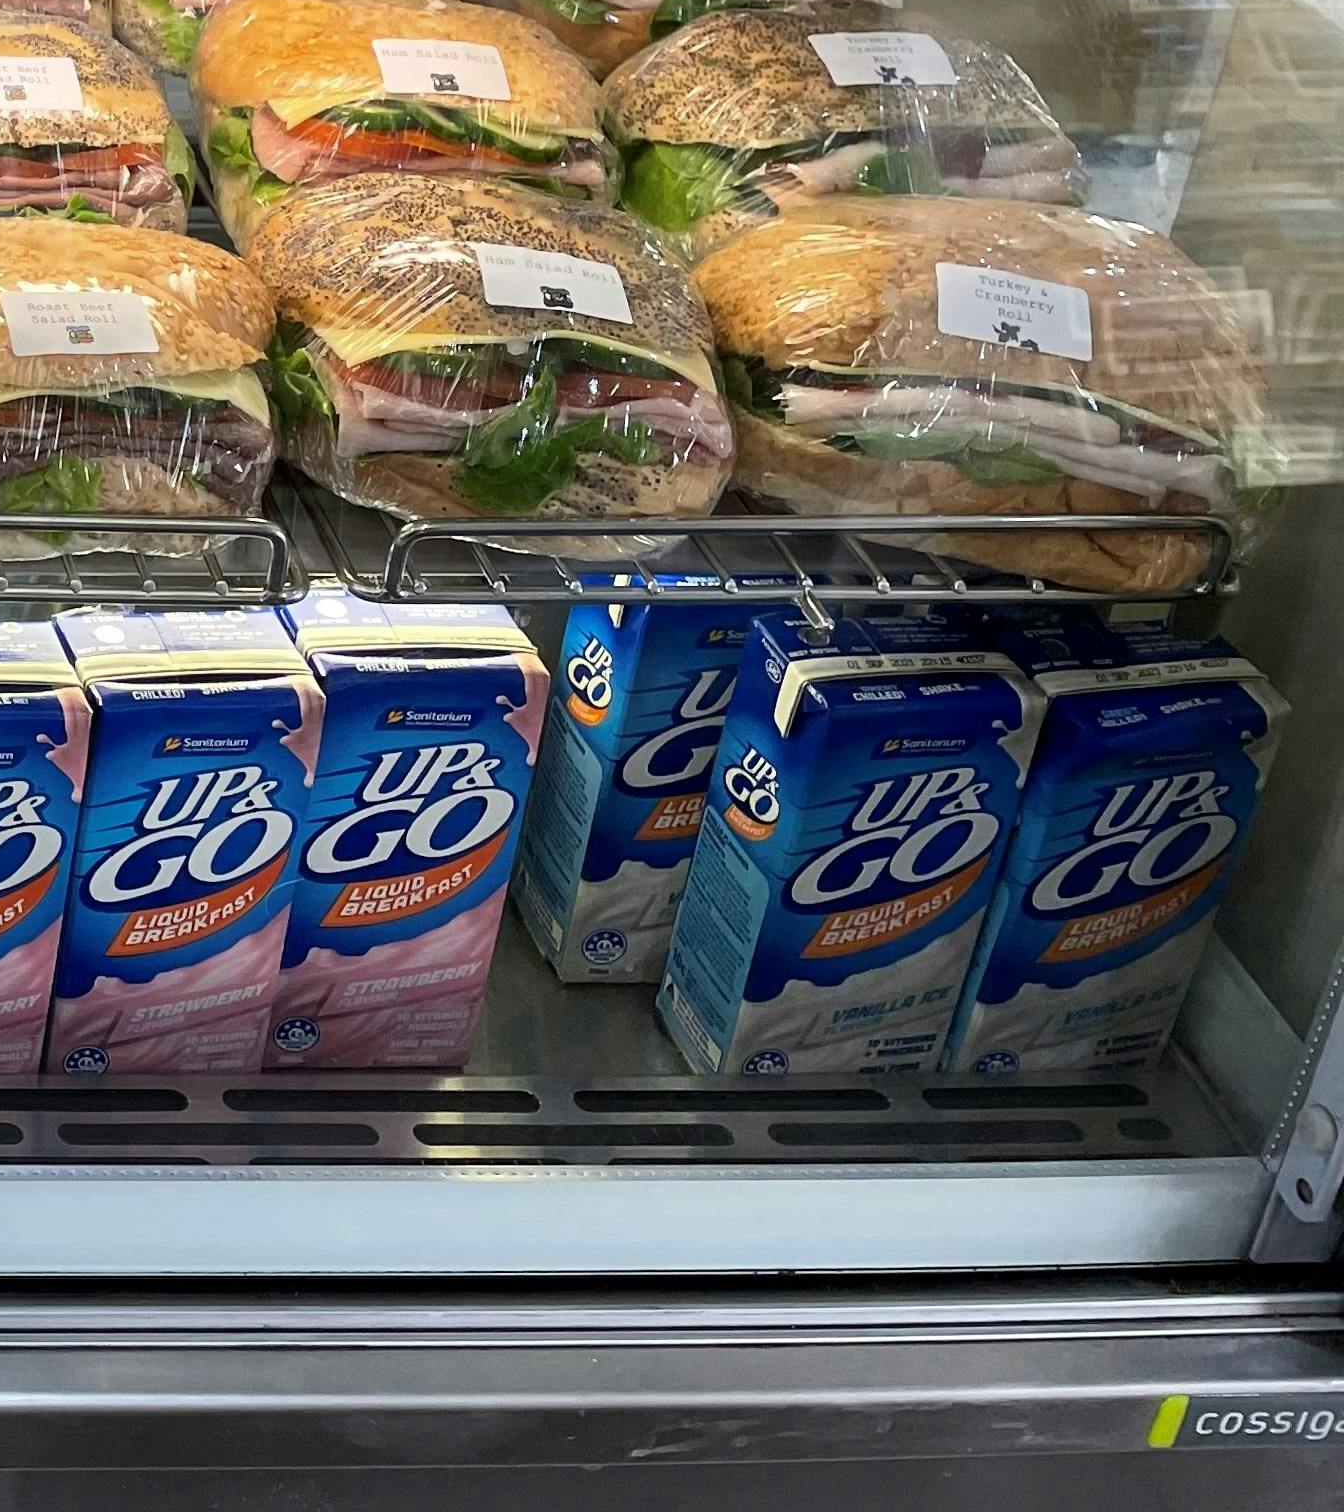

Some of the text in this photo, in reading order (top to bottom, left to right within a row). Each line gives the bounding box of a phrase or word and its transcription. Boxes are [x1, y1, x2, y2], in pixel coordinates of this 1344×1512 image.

[975, 288, 1054, 314] Cranberry
[978, 275, 1031, 294] Turkey
[998, 307, 1032, 323] Roll
[567, 657, 612, 709] GO
[406, 710, 471, 723] Sanitarium
[184, 737, 248, 748] Sanitarium
[902, 738, 966, 749] Sanitarium
[362, 743, 499, 802] UP&
[725, 766, 780, 824] GO
[742, 748, 779, 794] UP&
[142, 766, 278, 829] UP&
[852, 768, 989, 831] UP&
[306, 788, 514, 875] GO
[89, 810, 292, 903] GO
[792, 812, 999, 904] GO
[1032, 816, 1237, 910] GO
[340, 864, 473, 916] BREAKFAST
[349, 875, 424, 901] LIQUID
[125, 886, 256, 945] BREAKFAST
[134, 901, 208, 930] LIQUID
[820, 888, 954, 945] BREAKFAST
[830, 900, 907, 931] LIQUID
[131, 982, 269, 1022] STRAWBERRY
[344, 960, 483, 998] STRAWBERRY
